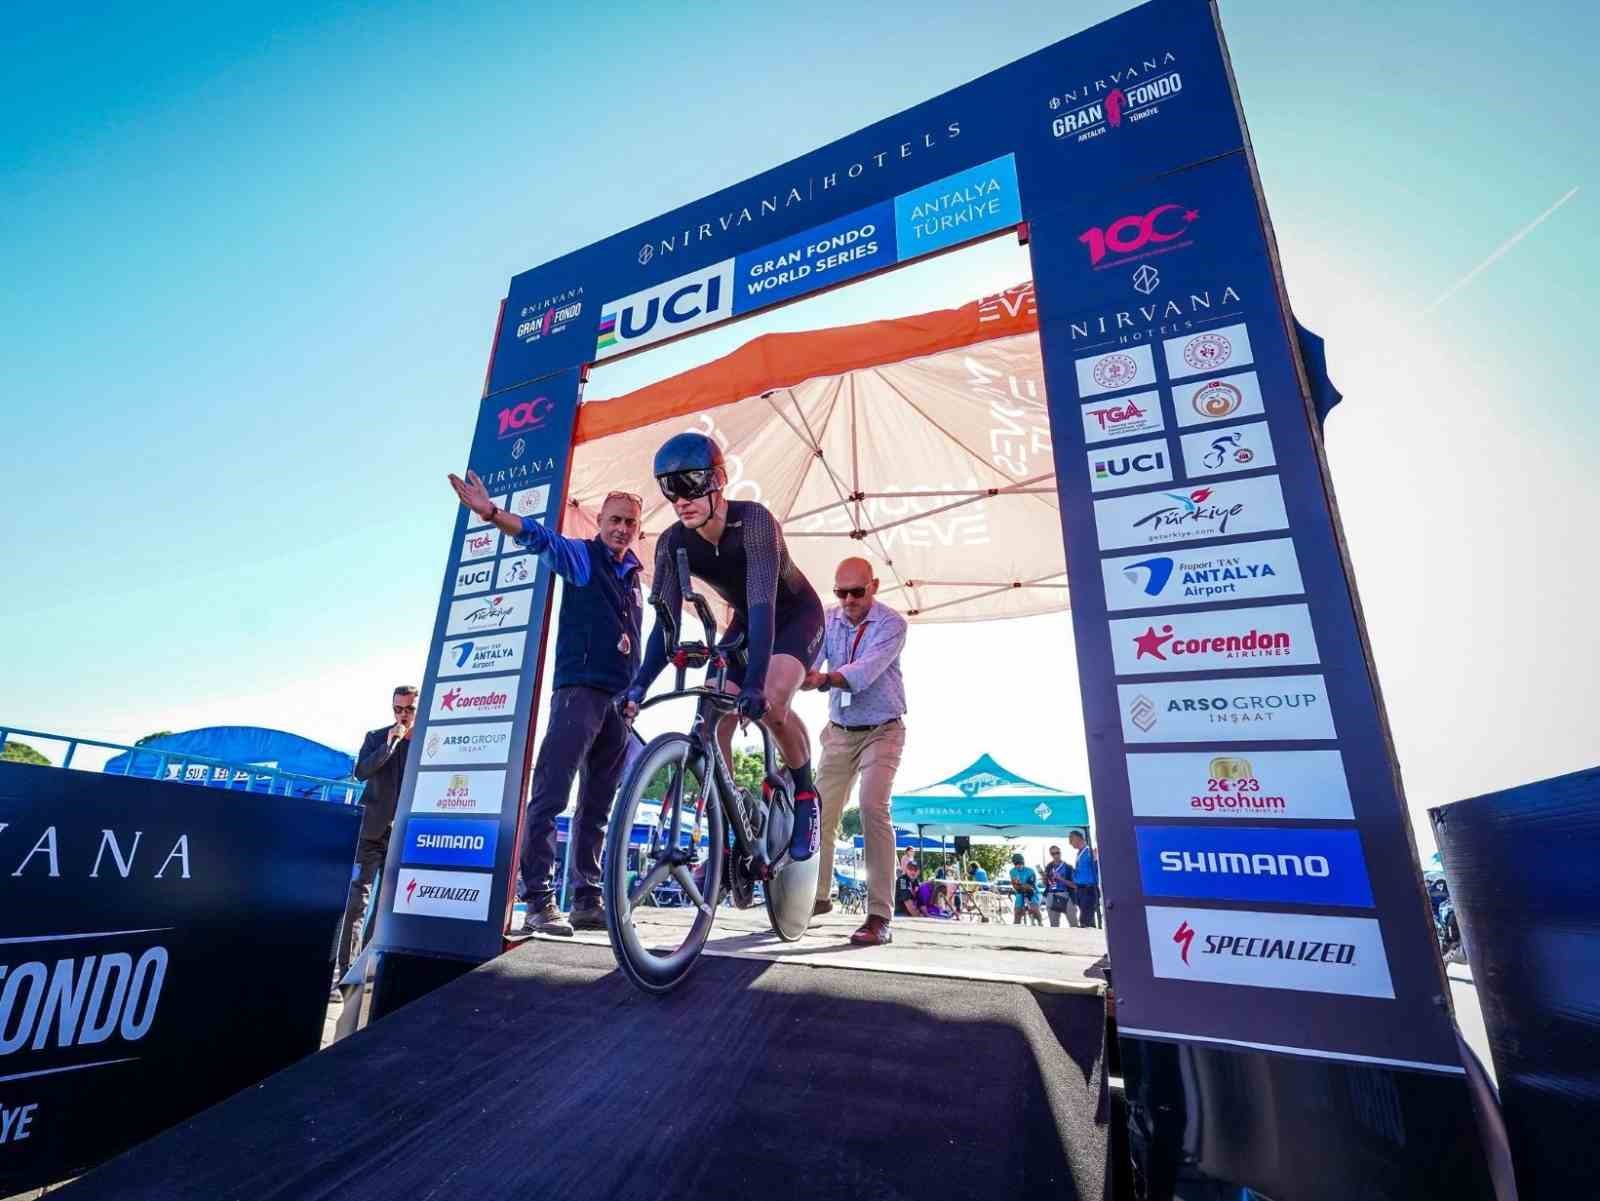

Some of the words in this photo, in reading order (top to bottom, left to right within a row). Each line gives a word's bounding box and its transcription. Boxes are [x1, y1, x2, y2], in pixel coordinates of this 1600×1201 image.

[1065, 52, 1175, 103] NIRVANA
[1052, 104, 1103, 138] GRAN
[1126, 72, 1183, 107] FONDO
[658, 188, 801, 256] NIRVANA
[823, 122, 960, 190] HOTELS
[911, 177, 1001, 222] ANTALYA
[912, 199, 1001, 239] TÜRKİYE
[749, 244, 801, 278] GRAN
[807, 224, 876, 259] FONDO
[747, 264, 811, 295] WORLD
[816, 241, 878, 273] SERIES
[517, 317, 543, 338] GRAN
[554, 302, 582, 323] FONDO
[619, 276, 721, 340] UCI
[1070, 286, 1240, 339] NIRVANA
[1120, 320, 1193, 344] HOTELS
[1085, 399, 1147, 431] TGA
[1107, 452, 1164, 476] UCI
[1182, 563, 1276, 585] ANTALYA
[1216, 557, 1240, 569] TAV
[464, 570, 490, 585] UCI
[1184, 583, 1236, 597] Airport
[473, 647, 513, 661] ANTALYA
[1172, 630, 1290, 655] corendon
[1227, 648, 1290, 658] AIRLINES
[456, 691, 507, 708] corendon
[1167, 697, 1228, 712] ARSO
[1233, 693, 1317, 710] GROUP
[443, 735, 469, 745] ARSO
[472, 733, 507, 745] GROUP
[1190, 793, 1286, 811] agtohum
[0, 822, 192, 879] ANA
[416, 834, 484, 850] SHIMANO
[1159, 850, 1330, 878] SHIMANO
[416, 885, 480, 902] SPECIALIZED
[1202, 934, 1355, 965] SPECIALIZED
[0, 946, 169, 1056] ONDO
